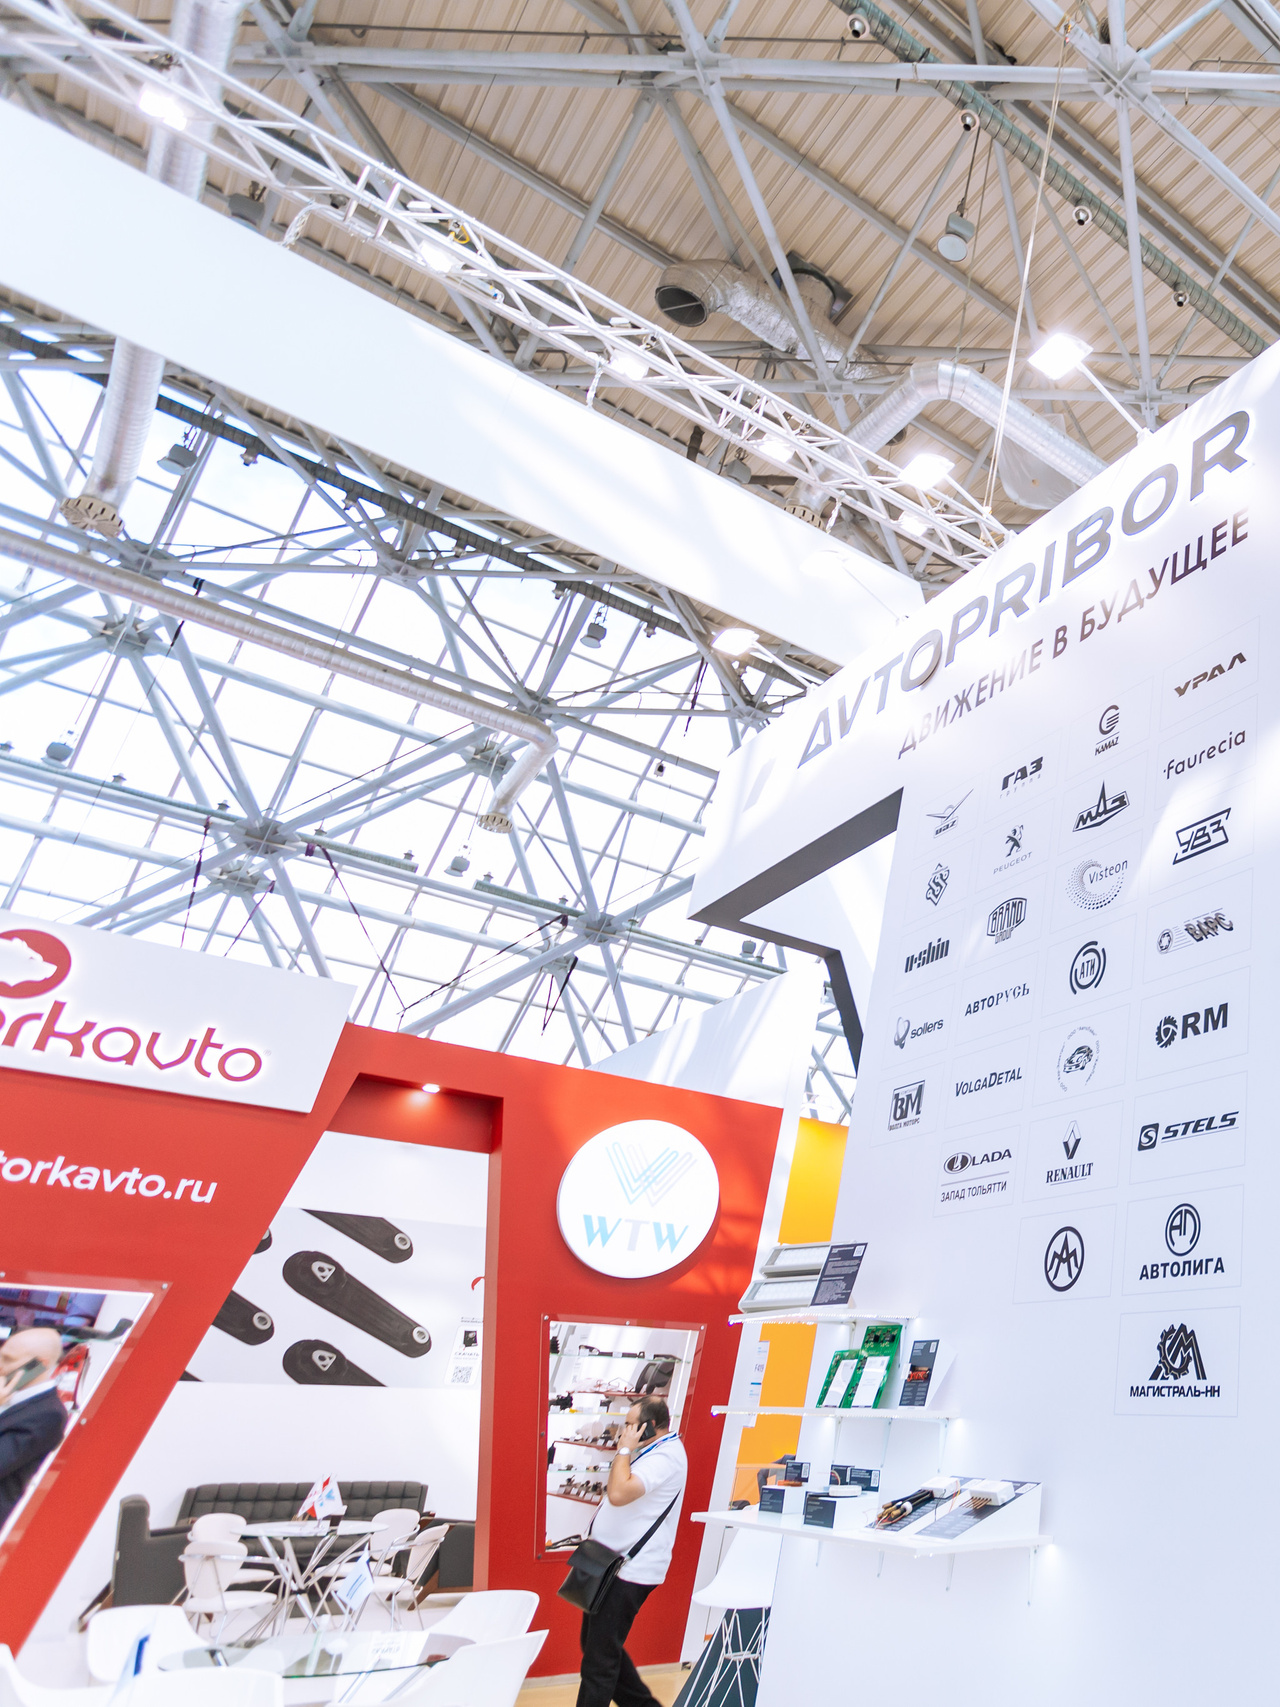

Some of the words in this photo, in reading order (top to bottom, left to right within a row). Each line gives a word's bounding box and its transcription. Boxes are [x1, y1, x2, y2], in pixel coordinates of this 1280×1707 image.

[797, 410, 1250, 769] AVTOPRIBOR
[898, 638, 1043, 760] ДВИЖЕНИЕ
[1052, 623, 1068, 660] В
[1080, 508, 1249, 642] БУДУЩЕЕ
[1173, 652, 1247, 697] УРАЛ
[1164, 730, 1246, 780] faurecia
[1001, 756, 1044, 791] ГАЗ
[993, 851, 1033, 875] PEUGEOT
[1089, 859, 1128, 885] Visteon
[910, 1019, 944, 1039] sollers
[1180, 1002, 1229, 1040] RM
[0, 1000, 263, 1083] rkavto
[1161, 1111, 1240, 1141] STELS
[971, 1148, 1012, 1167] LADA
[1046, 1162, 1094, 1184] RENAULT
[940, 1187, 966, 1203] ЗАПАД
[967, 1181, 1007, 1199] ТОЛЬЯТТИ
[583, 1214, 689, 1254] WTW
[1139, 1257, 1225, 1280] АВТОЛИГА
[1129, 1385, 1221, 1398] МАГИСТРАЛЬ-НН
